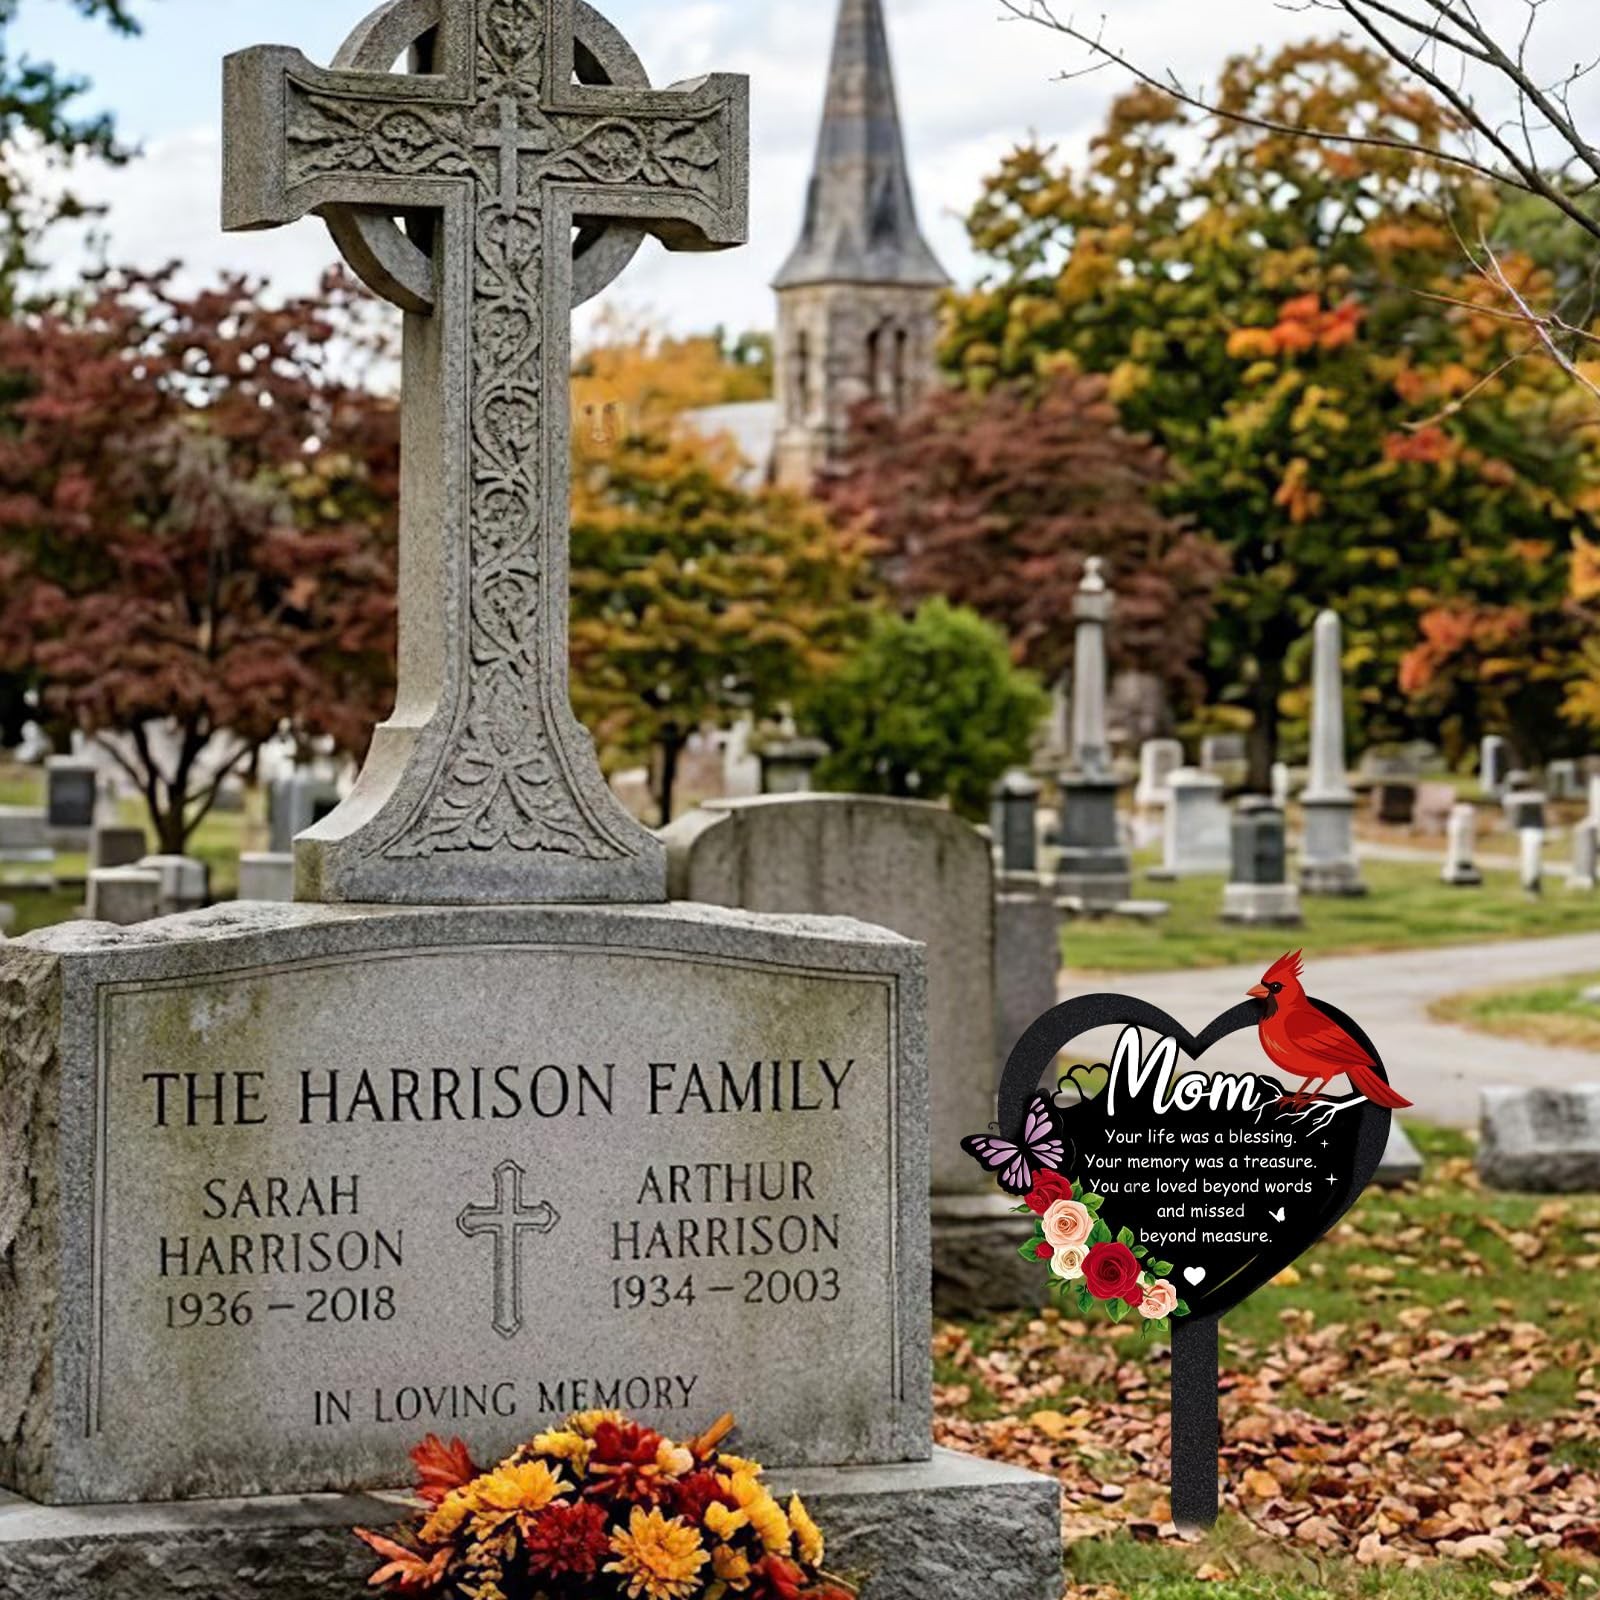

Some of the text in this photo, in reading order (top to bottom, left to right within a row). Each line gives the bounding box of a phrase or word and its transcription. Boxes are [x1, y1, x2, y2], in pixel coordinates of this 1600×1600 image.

[1107, 1026, 1262, 1116] Mom
[142, 1059, 855, 1127] THE HARRISON FAMILY
[1105, 1129, 1297, 1149] Your life was a blessing.
[637, 1161, 815, 1204] ARTHUR
[1085, 1154, 1317, 1173] Your memory was a treasure.
[203, 1175, 360, 1219] SARAH
[1090, 1179, 1313, 1197] You are loved beyond words
[1157, 1204, 1245, 1218] and missed
[159, 1230, 403, 1277] HARRISON
[611, 1214, 839, 1260] HARRISON
[1140, 1228, 1272, 1247] beyond measure.
[167, 1291, 253, 1328] 1936
[306, 1286, 396, 1322] 2018
[612, 1275, 696, 1309] 1934
[744, 1269, 840, 1304] 2003
[314, 1376, 698, 1426] IN LOVING MEMORY
